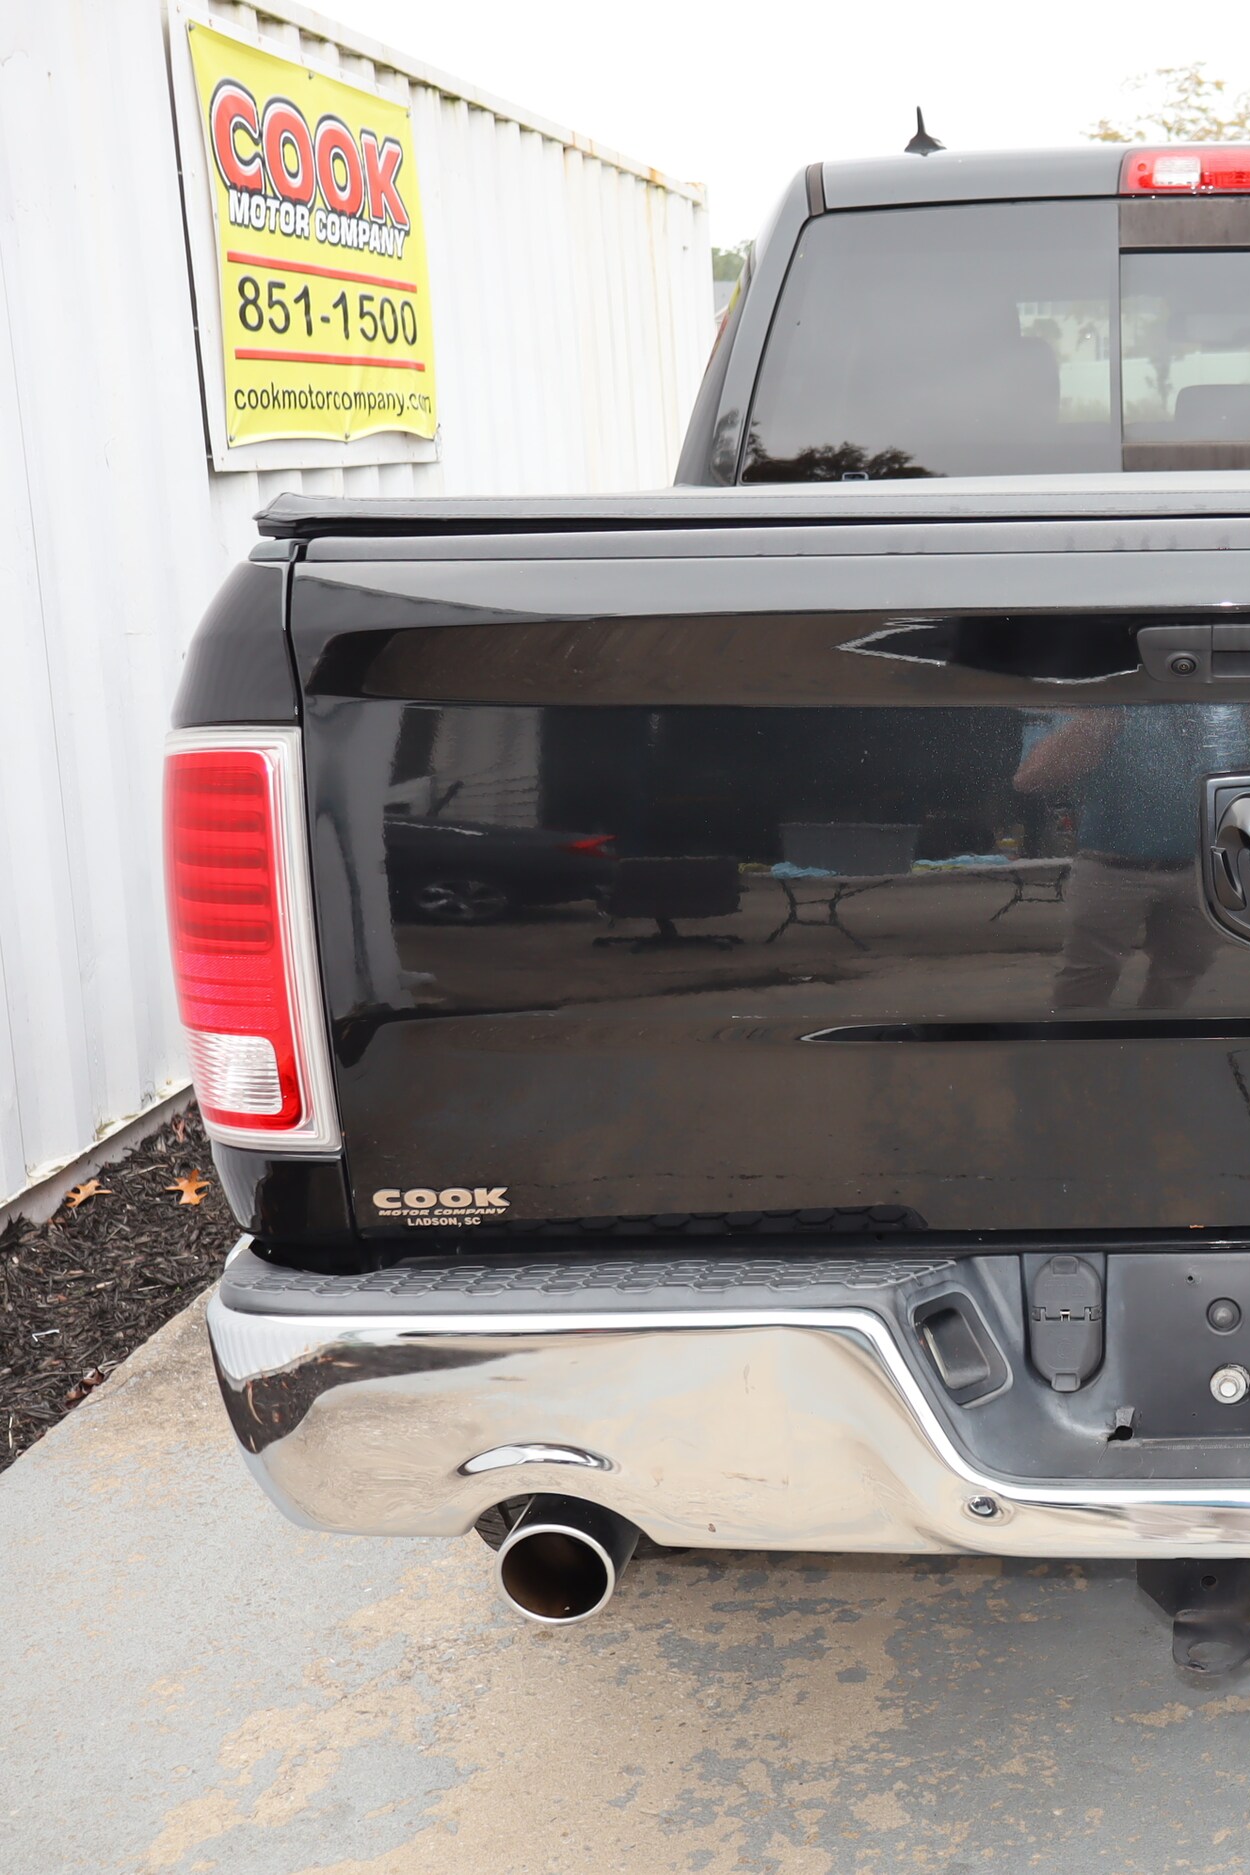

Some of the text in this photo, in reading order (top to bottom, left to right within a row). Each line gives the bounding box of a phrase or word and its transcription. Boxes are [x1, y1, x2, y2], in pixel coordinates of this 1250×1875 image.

[210, 79, 410, 236] COOK
[229, 189, 406, 259] MOTOR COMPANY
[238, 276, 417, 346] 851-1500
[372, 1187, 510, 1209] COOK
[433, 1208, 507, 1216] COMPANY
[407, 1216, 481, 1227] LADSON, SC
